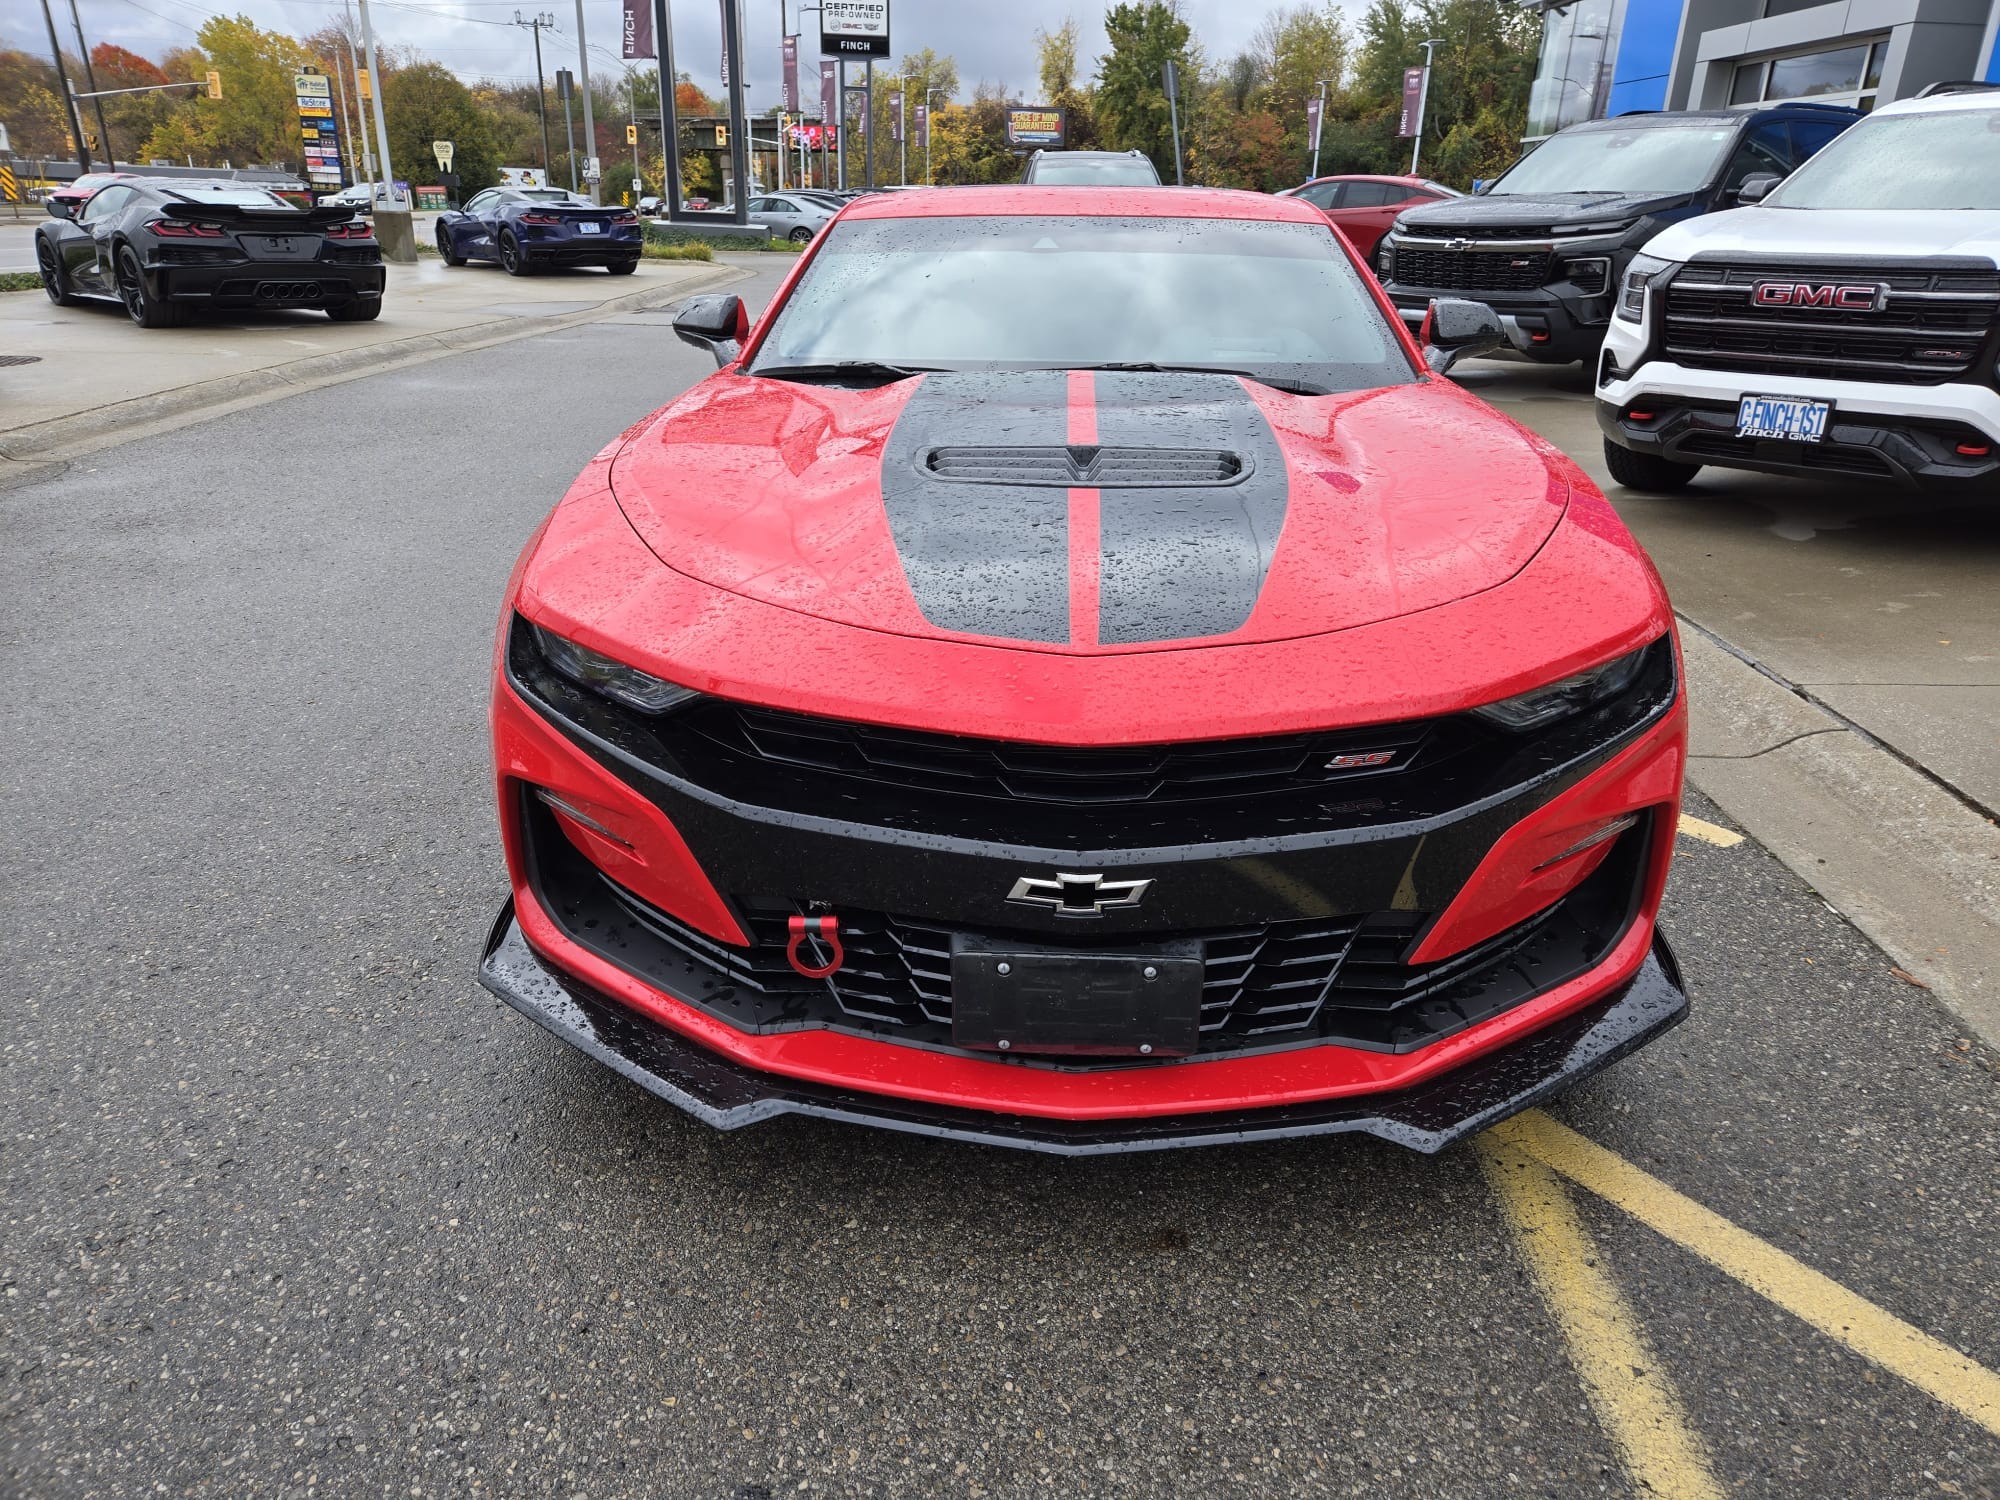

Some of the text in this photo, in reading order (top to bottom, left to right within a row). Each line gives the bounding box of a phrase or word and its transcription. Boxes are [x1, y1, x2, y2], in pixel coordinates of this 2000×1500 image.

[826, 3, 883, 11] CERTIFIED
[828, 10, 881, 19] PRE-OWNED
[841, 41, 870, 50] FINCH
[1012, 112, 1059, 121] PEACE OF MIND
[1015, 122, 1055, 130] GUARANTEED
[1757, 283, 1875, 309] GMC
[1735, 425, 1820, 442] finch GMC
[1324, 750, 1397, 769] SS
